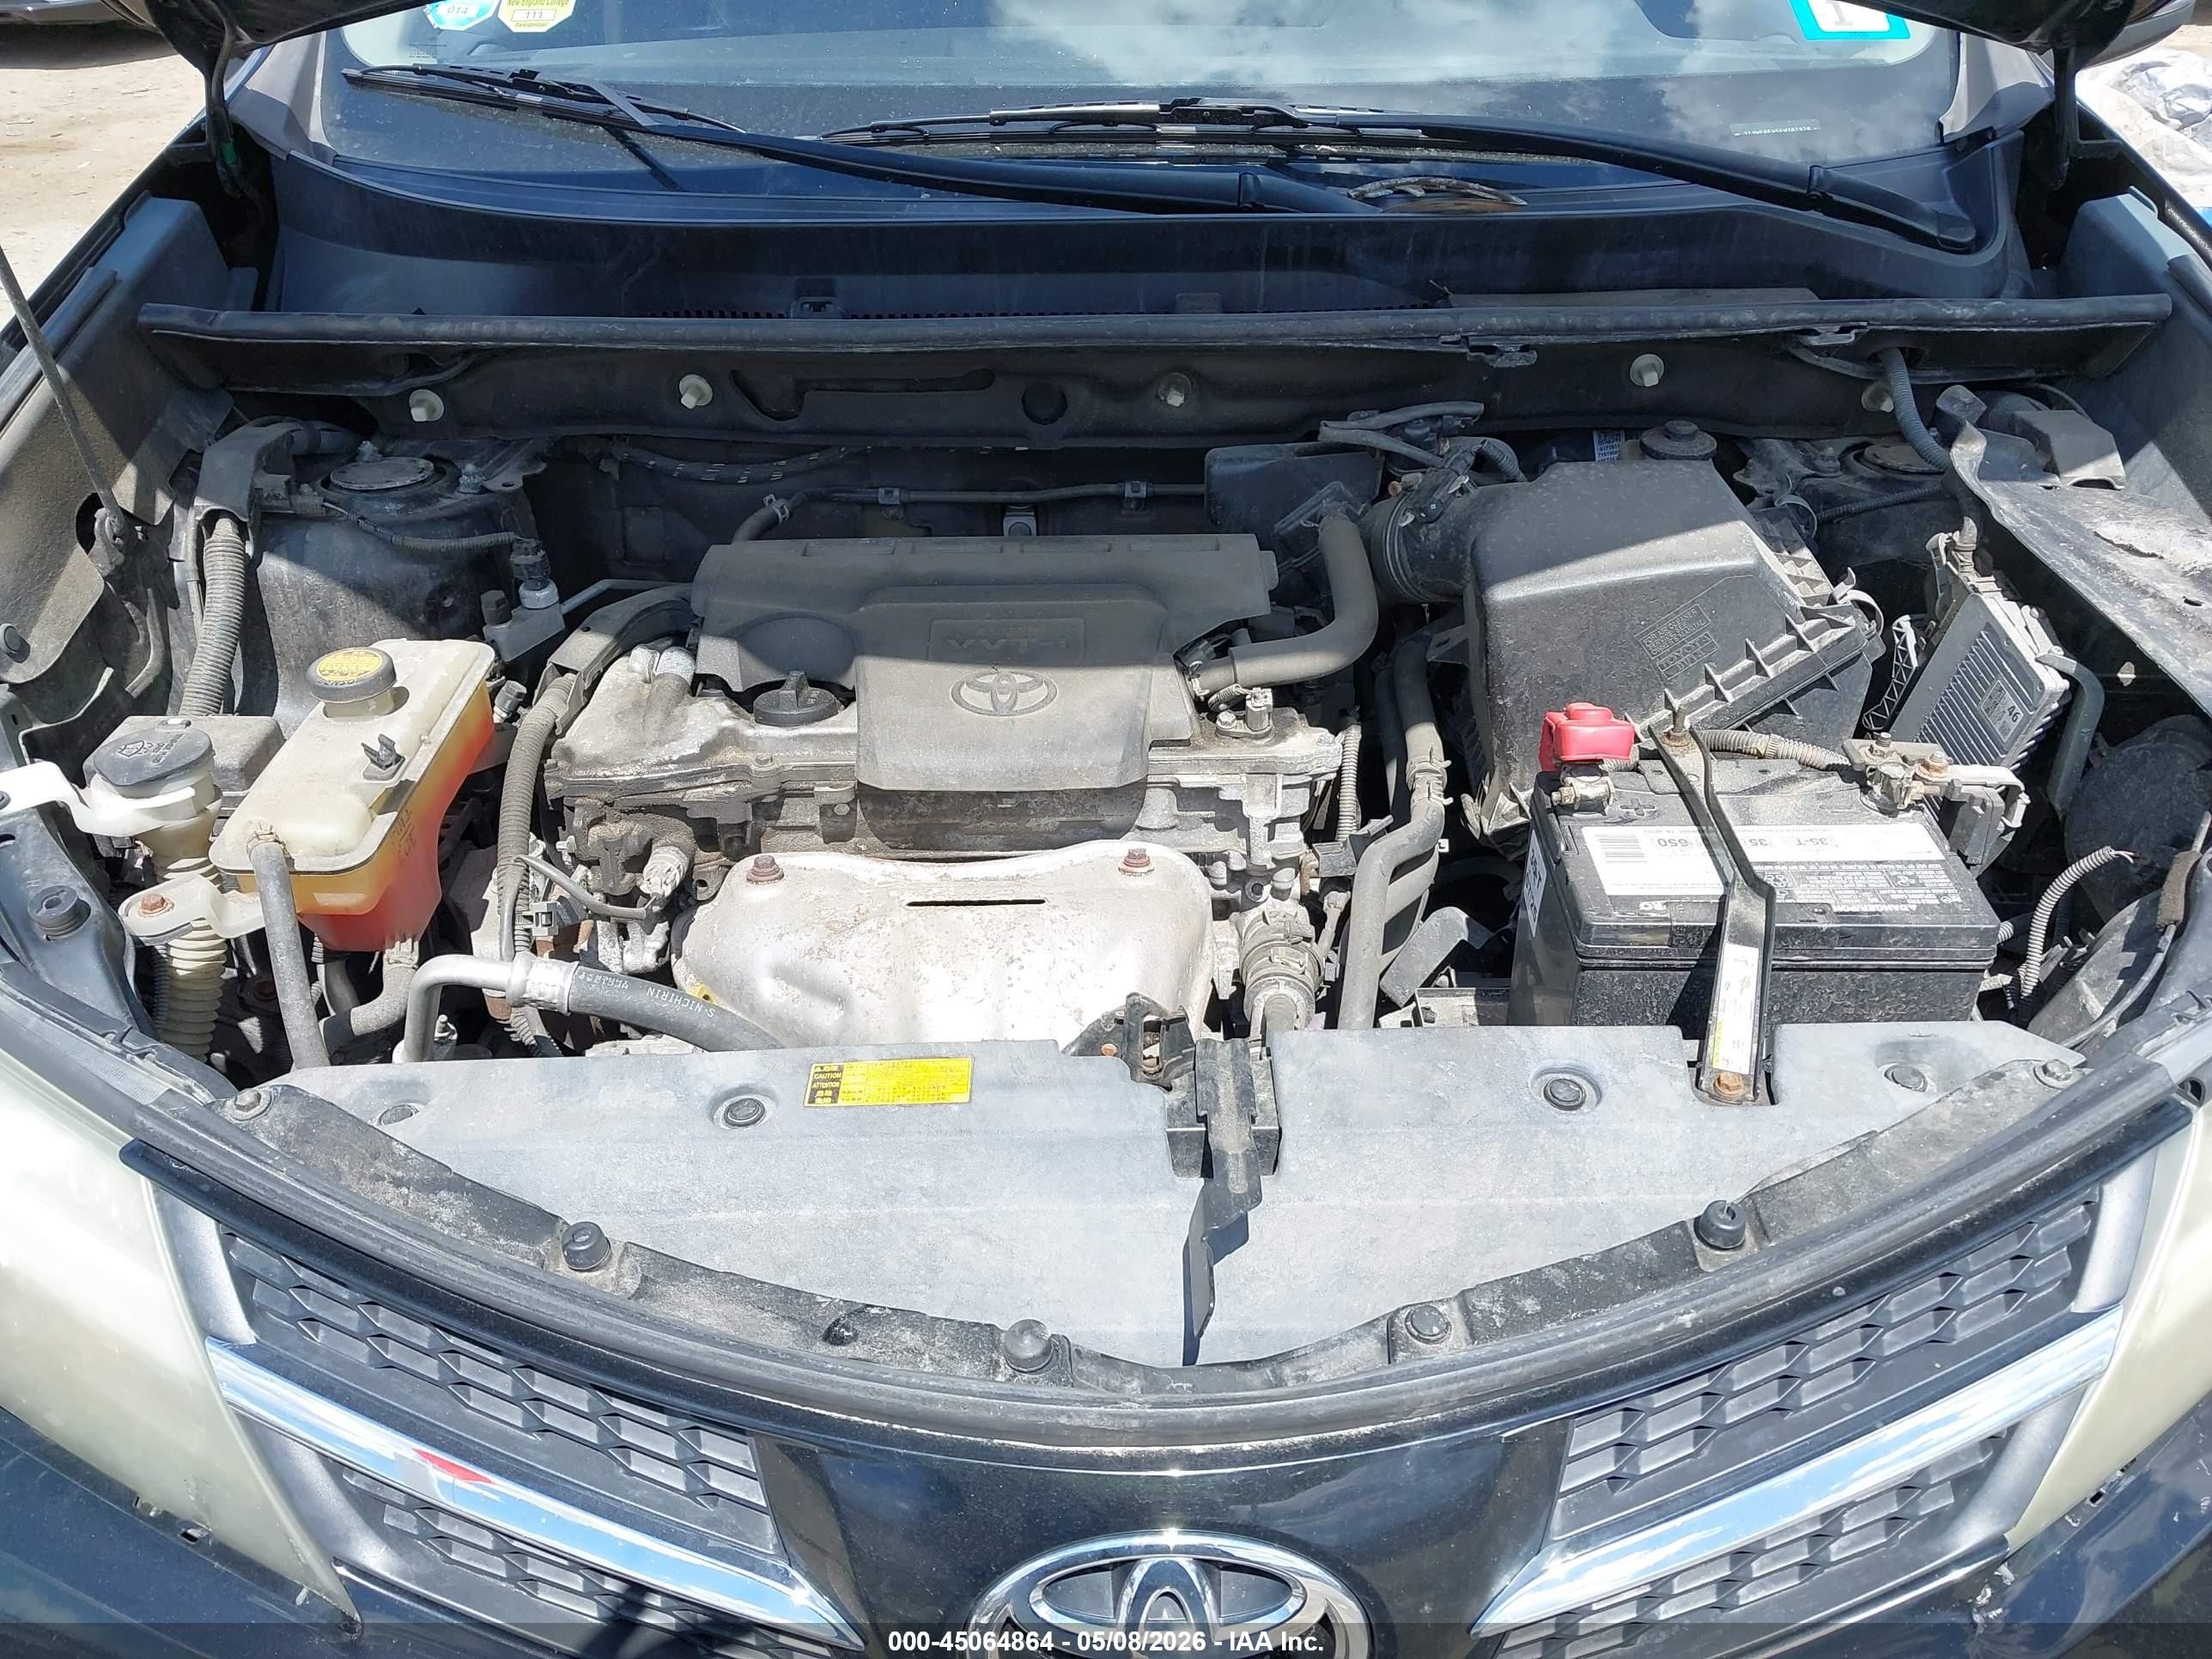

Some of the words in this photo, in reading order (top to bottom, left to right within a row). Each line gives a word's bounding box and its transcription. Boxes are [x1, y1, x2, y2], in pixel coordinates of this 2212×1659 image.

[1657, 635, 1711, 668] TOYOTA
[2007, 705, 2021, 723] 46
[1657, 837, 1689, 847] 650
[1796, 837, 1828, 846] 35-T
